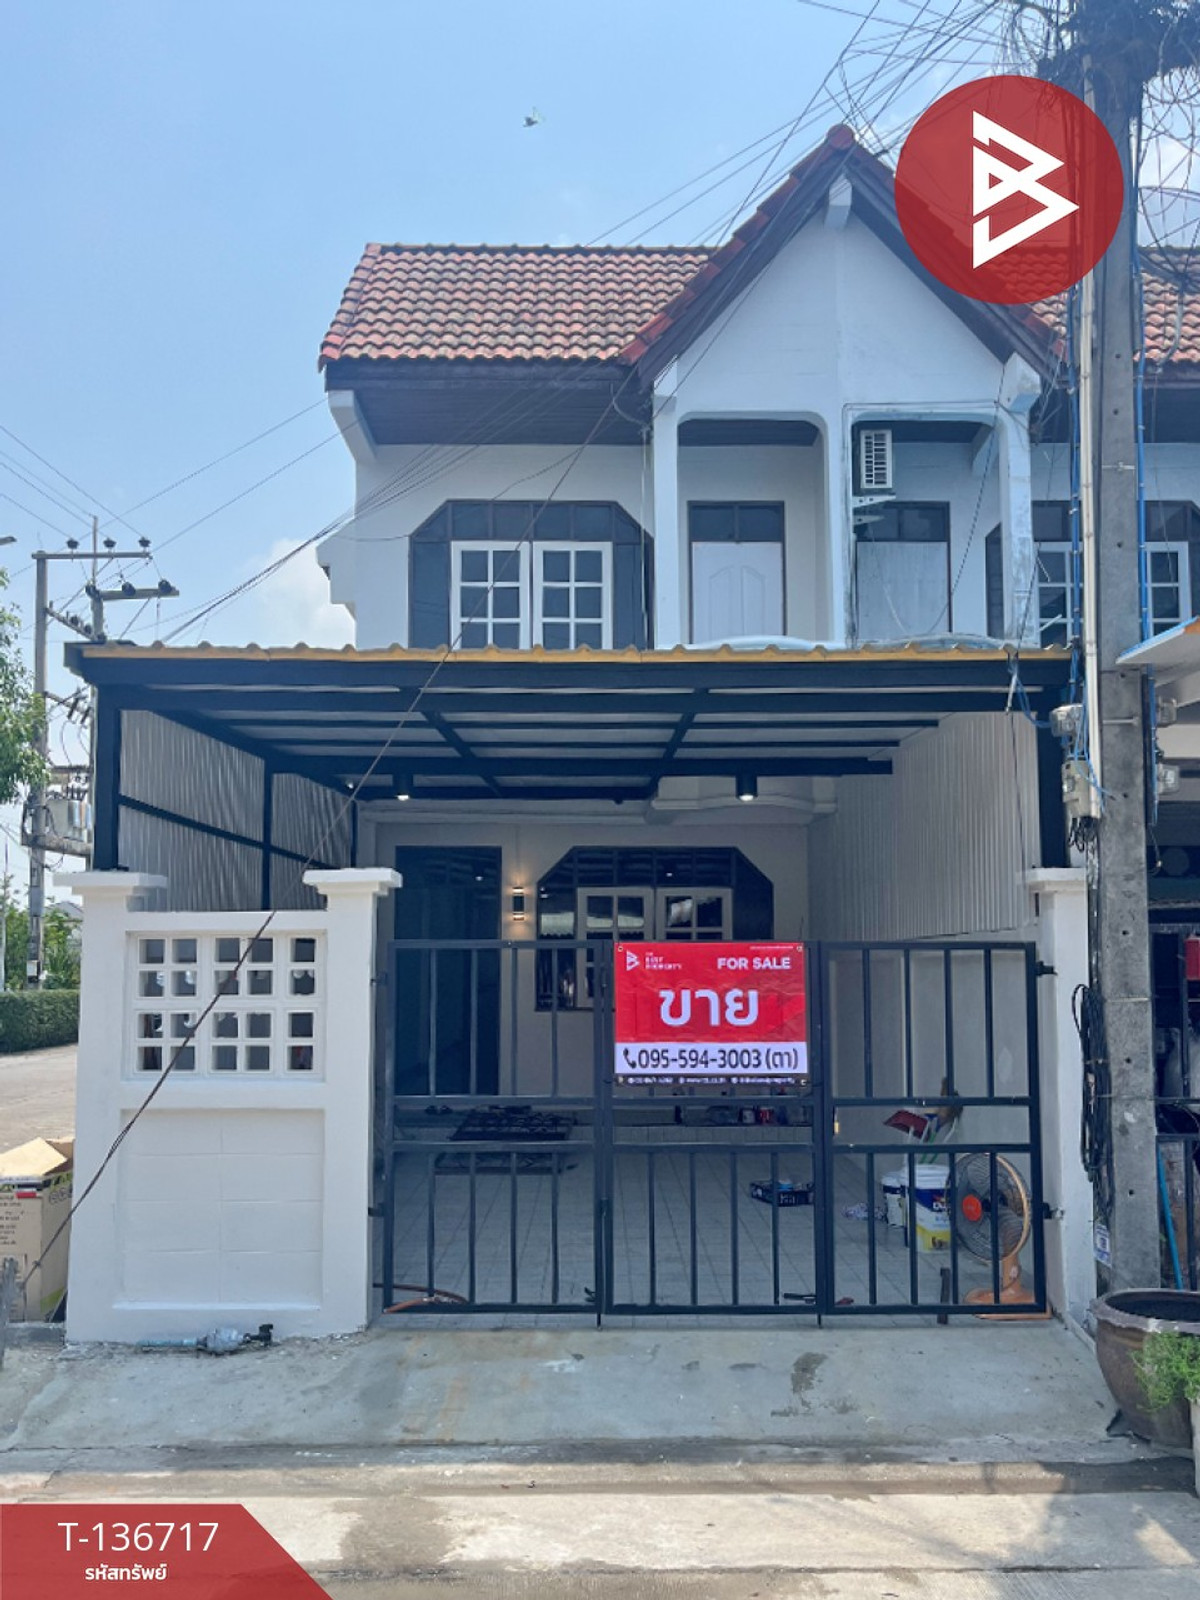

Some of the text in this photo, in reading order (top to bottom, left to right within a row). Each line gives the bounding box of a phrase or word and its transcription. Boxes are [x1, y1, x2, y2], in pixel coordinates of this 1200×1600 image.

[717, 957, 791, 970] FOR SALE
[659, 988, 759, 1027] ขาย
[638, 1049, 762, 1069] 095-594-3003
